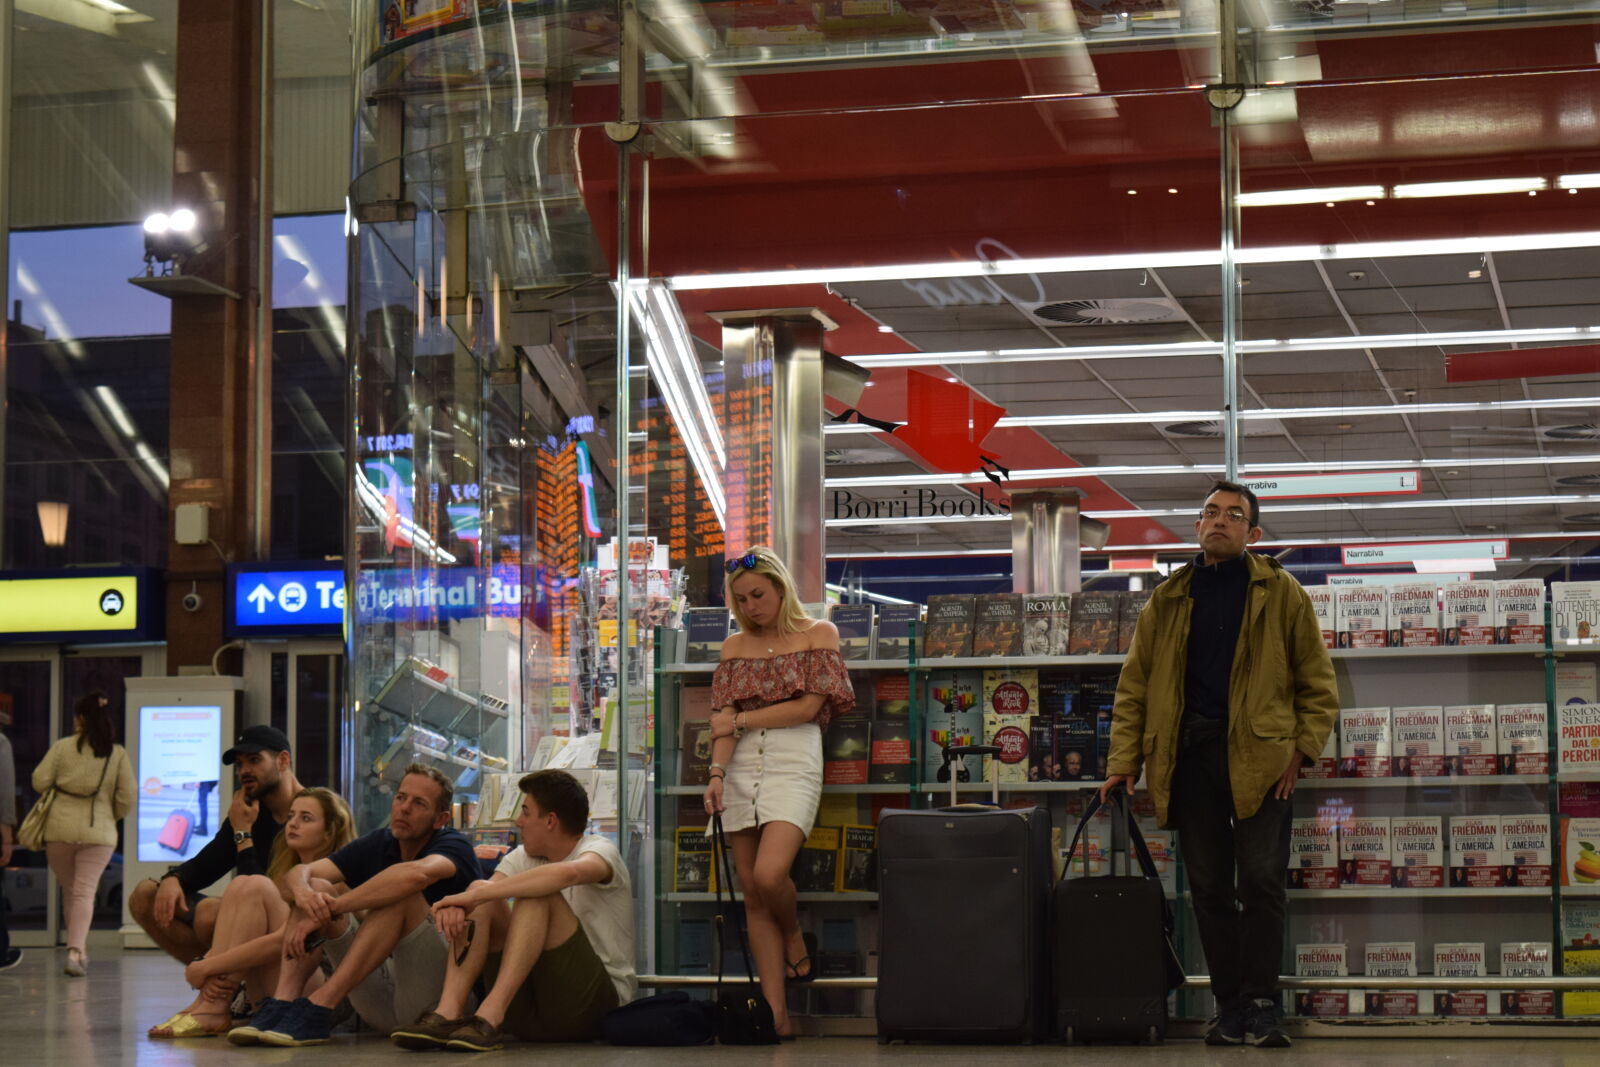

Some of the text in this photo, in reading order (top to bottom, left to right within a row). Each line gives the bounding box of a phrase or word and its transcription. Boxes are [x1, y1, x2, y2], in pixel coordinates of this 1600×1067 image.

[1346, 550, 1384, 558] Narrativa
[1390, 590, 1433, 601] FRIEDMAN
[1446, 589, 1489, 599] FRIEDMAN
[1496, 588, 1539, 598] FRIEDMAN
[1339, 594, 1382, 602] FRIEDMAN
[1026, 601, 1066, 612] ROMA
[1393, 605, 1431, 615] L'AMERICA
[1448, 603, 1486, 613] L'AMERICA
[1498, 603, 1536, 612] L'AMERICA
[1342, 608, 1379, 616] L'AMERICA
[1555, 612, 1570, 628] DI
[1344, 717, 1387, 727] FRIEDMAN
[1395, 716, 1438, 726] FRIEDMAN
[1448, 715, 1491, 725] FRIEDMAN
[1501, 714, 1544, 723] FRIEDMAN
[1347, 733, 1384, 742] L'AMERICA
[1398, 732, 1436, 741] L'AMERICA
[1451, 730, 1488, 740] L'AMERICA
[1504, 730, 1542, 738] L'AMERICA
[1572, 740, 1590, 748] DAL
[1290, 828, 1332, 837] FRIEDMAN
[1343, 827, 1386, 836] FRIEDMAN
[1394, 827, 1437, 836] FRIEDMAN
[1452, 825, 1496, 835] FRIEDMAN
[1503, 825, 1547, 834] FRIEDMAN
[1293, 843, 1330, 852] L'AMERICA
[1346, 842, 1383, 851] L'AMERICA
[1397, 842, 1435, 851] L'AMERICA
[1456, 841, 1493, 850] L'AMERICA
[1506, 841, 1544, 850] L'AMERICA
[1299, 954, 1341, 963] FRIEDMAN
[1368, 953, 1411, 962] FRIEDMAN
[1437, 953, 1480, 962] FRIEDMAN
[1504, 953, 1548, 962] FRIEDMAN
